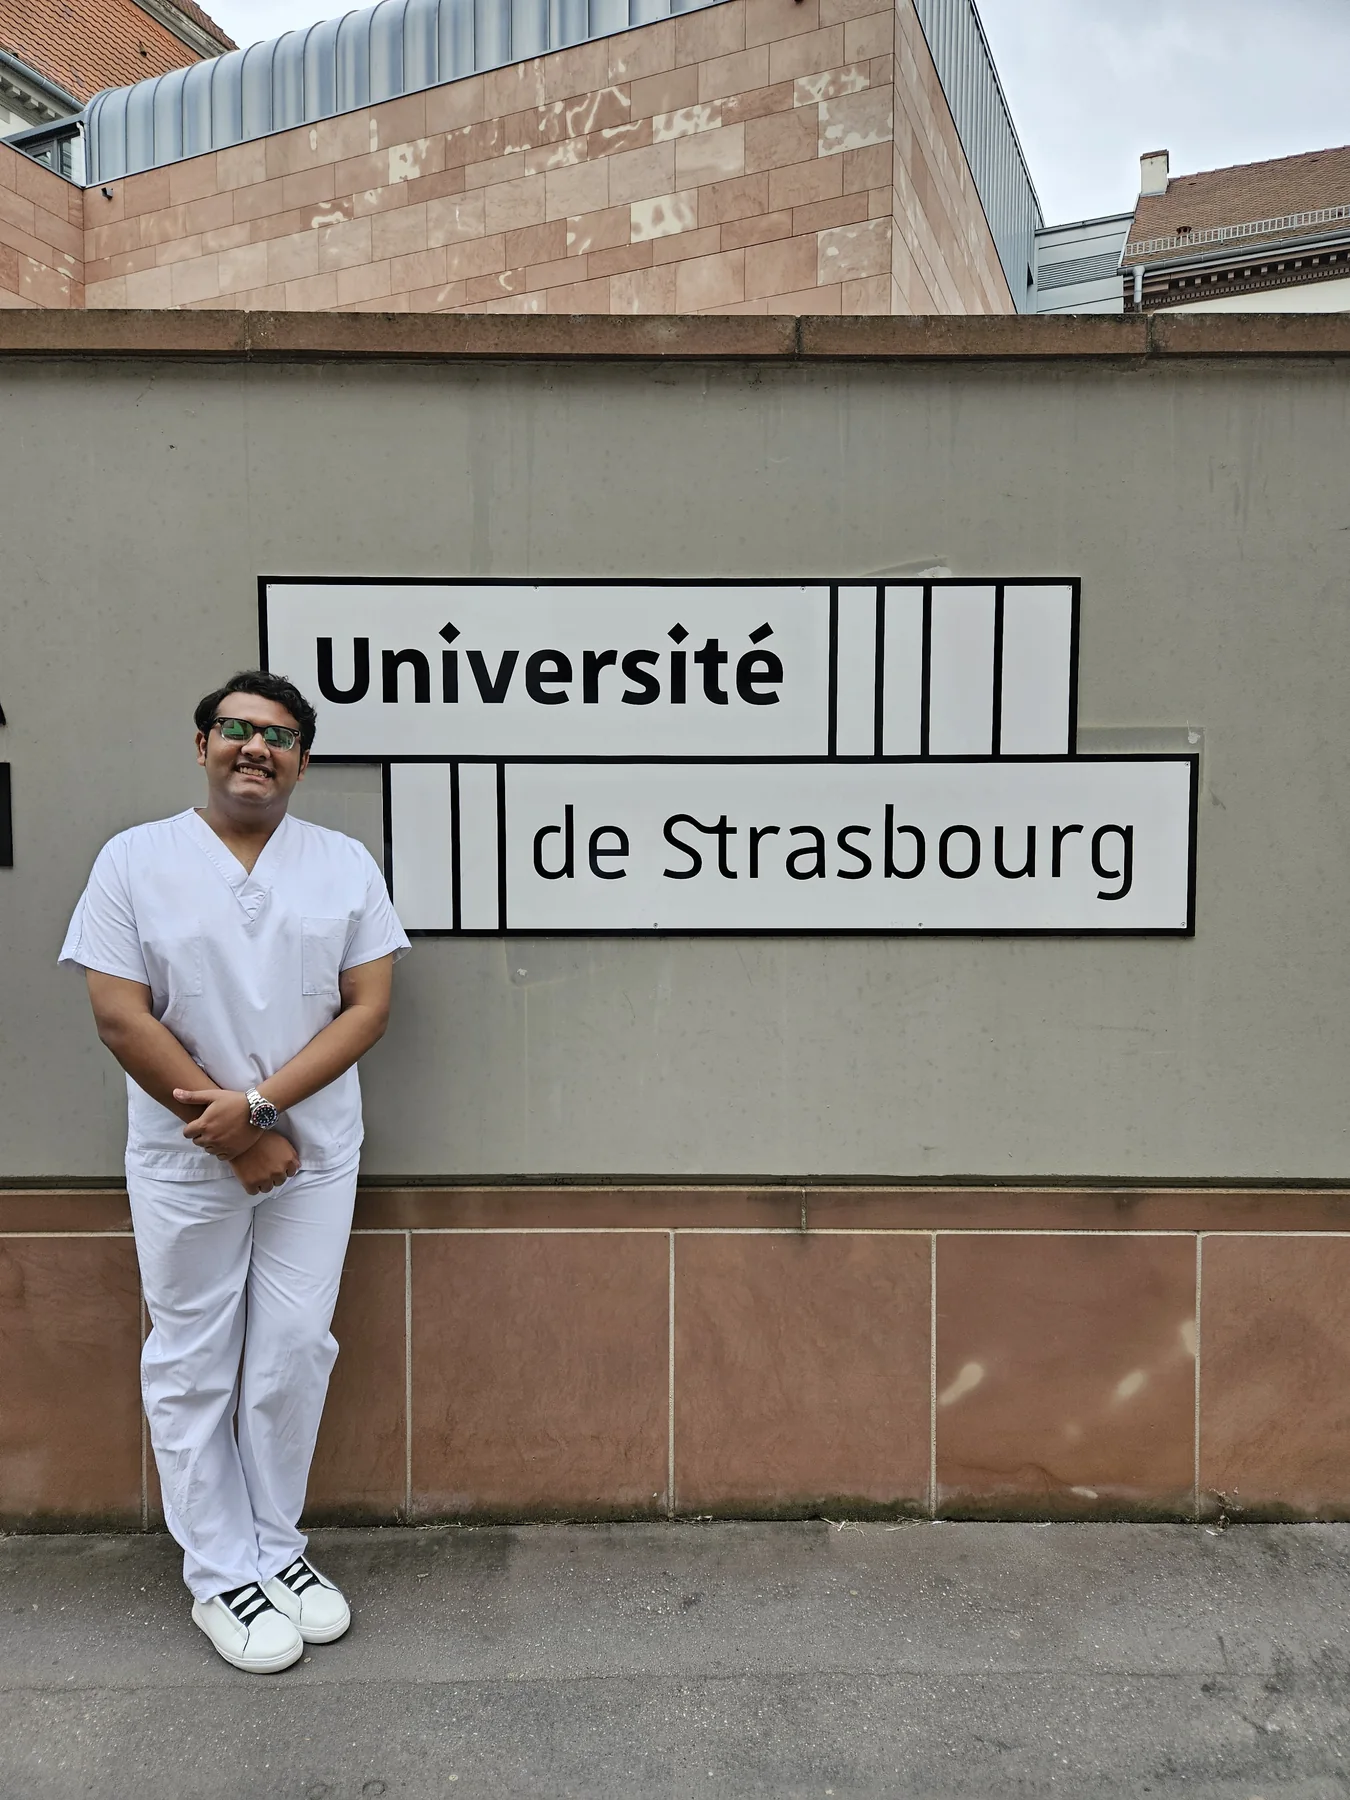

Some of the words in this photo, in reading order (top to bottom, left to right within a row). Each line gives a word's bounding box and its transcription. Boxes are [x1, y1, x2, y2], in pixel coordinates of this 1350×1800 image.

[316, 621, 784, 706] Université
[533, 804, 630, 880] de
[662, 803, 1134, 901] Strasbourg
